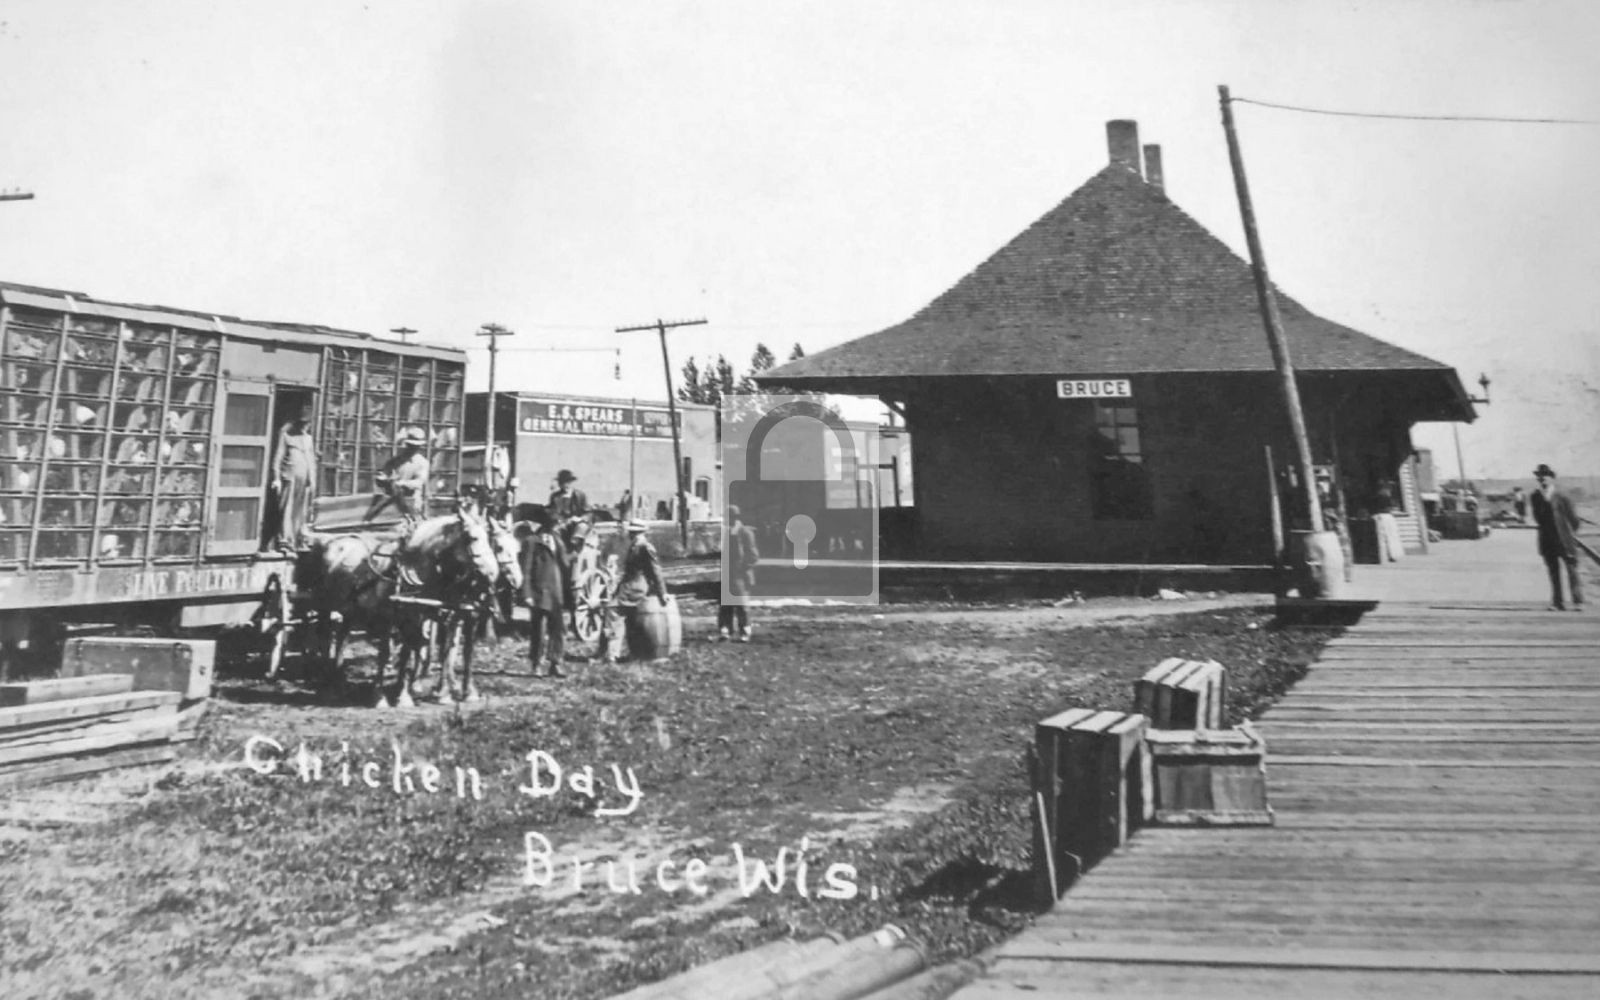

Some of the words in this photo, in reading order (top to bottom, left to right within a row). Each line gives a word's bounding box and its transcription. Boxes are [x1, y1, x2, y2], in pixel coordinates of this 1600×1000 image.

[1062, 381, 1127, 396] BRUCE
[575, 406, 624, 423] SPEARS
[524, 417, 581, 433] GENERAL
